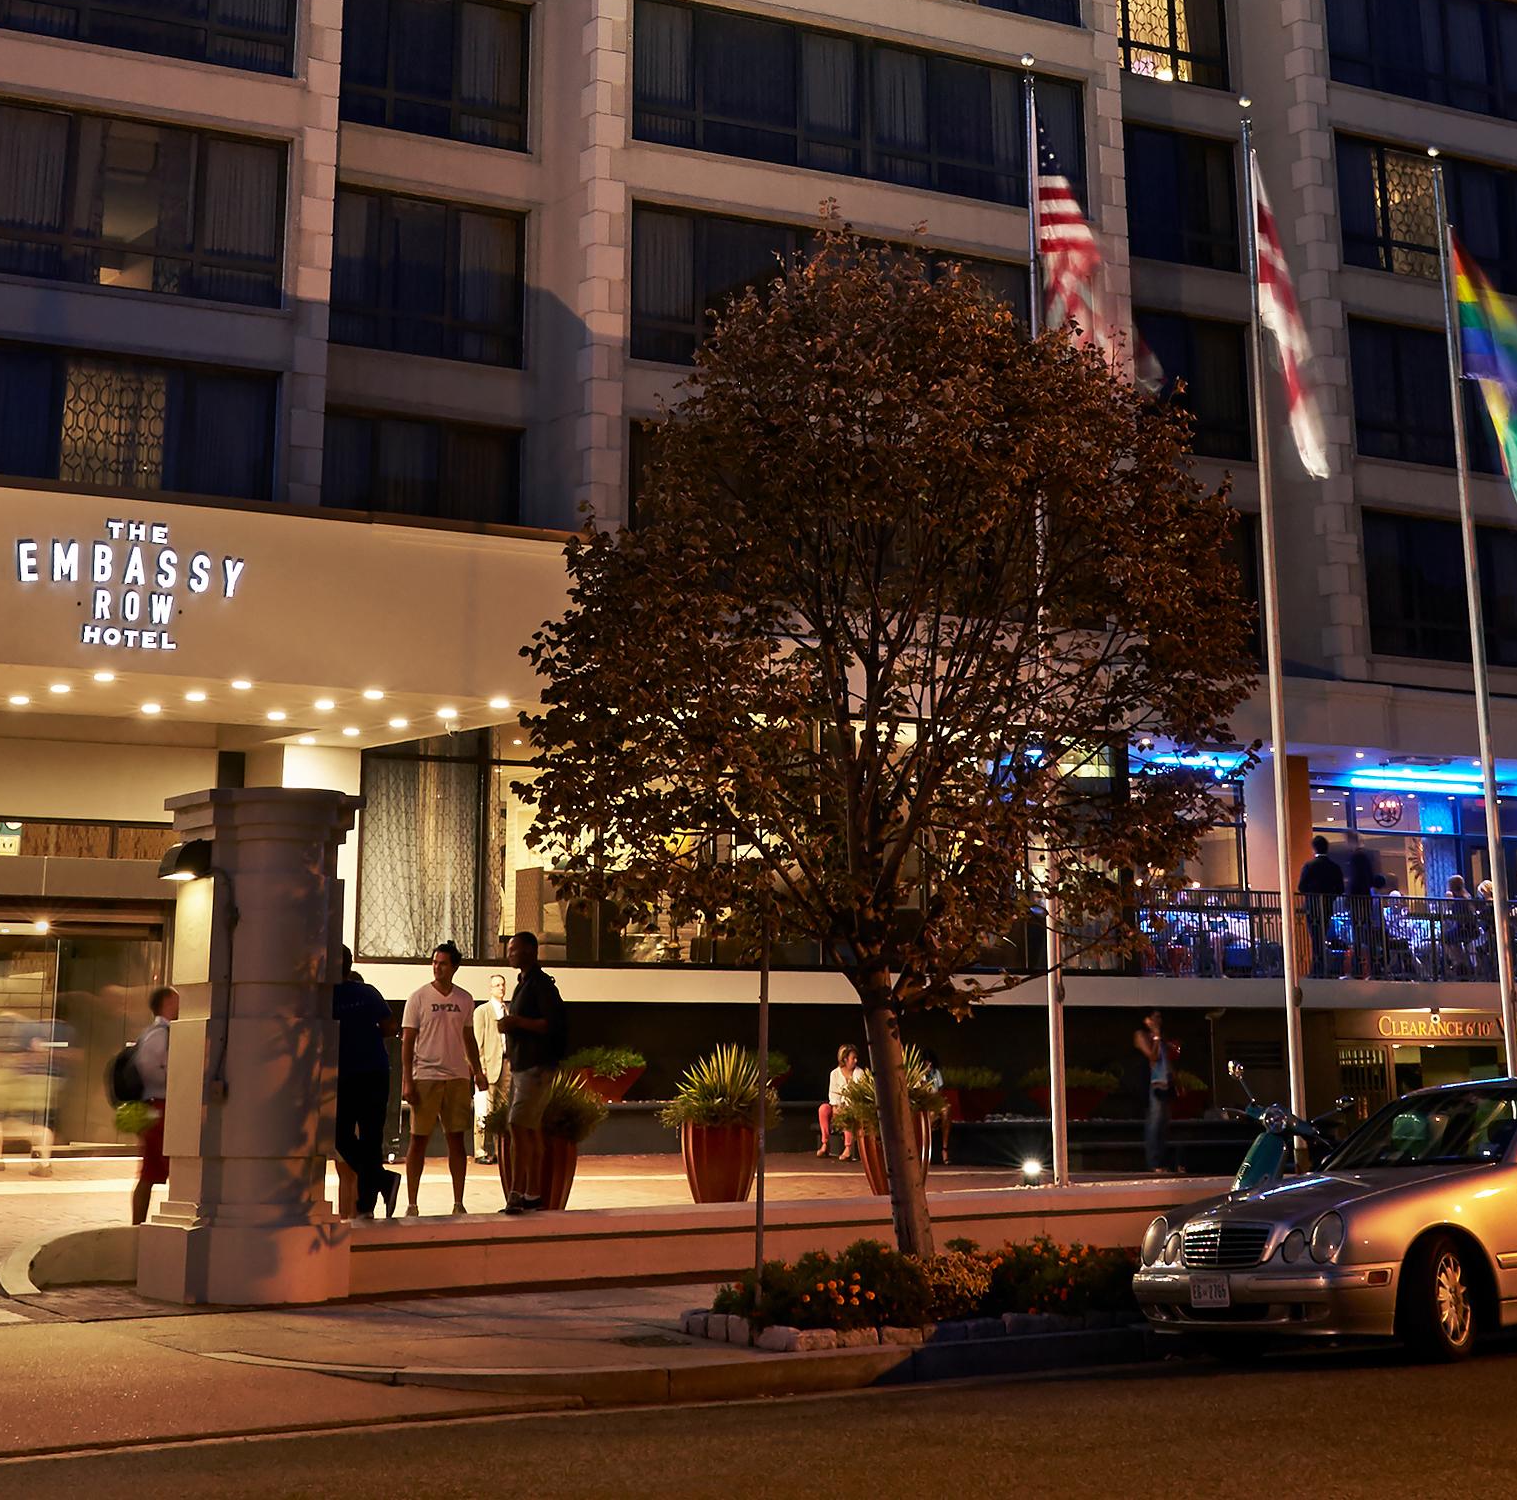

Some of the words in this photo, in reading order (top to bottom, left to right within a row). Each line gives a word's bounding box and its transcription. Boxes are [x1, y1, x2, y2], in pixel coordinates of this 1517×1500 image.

[107, 518, 169, 545] THE
[17, 538, 244, 598] EMBASSY
[93, 586, 174, 625] ROW
[82, 623, 177, 650] HOTEL
[1378, 1015, 1464, 1037] CLEARANCE
